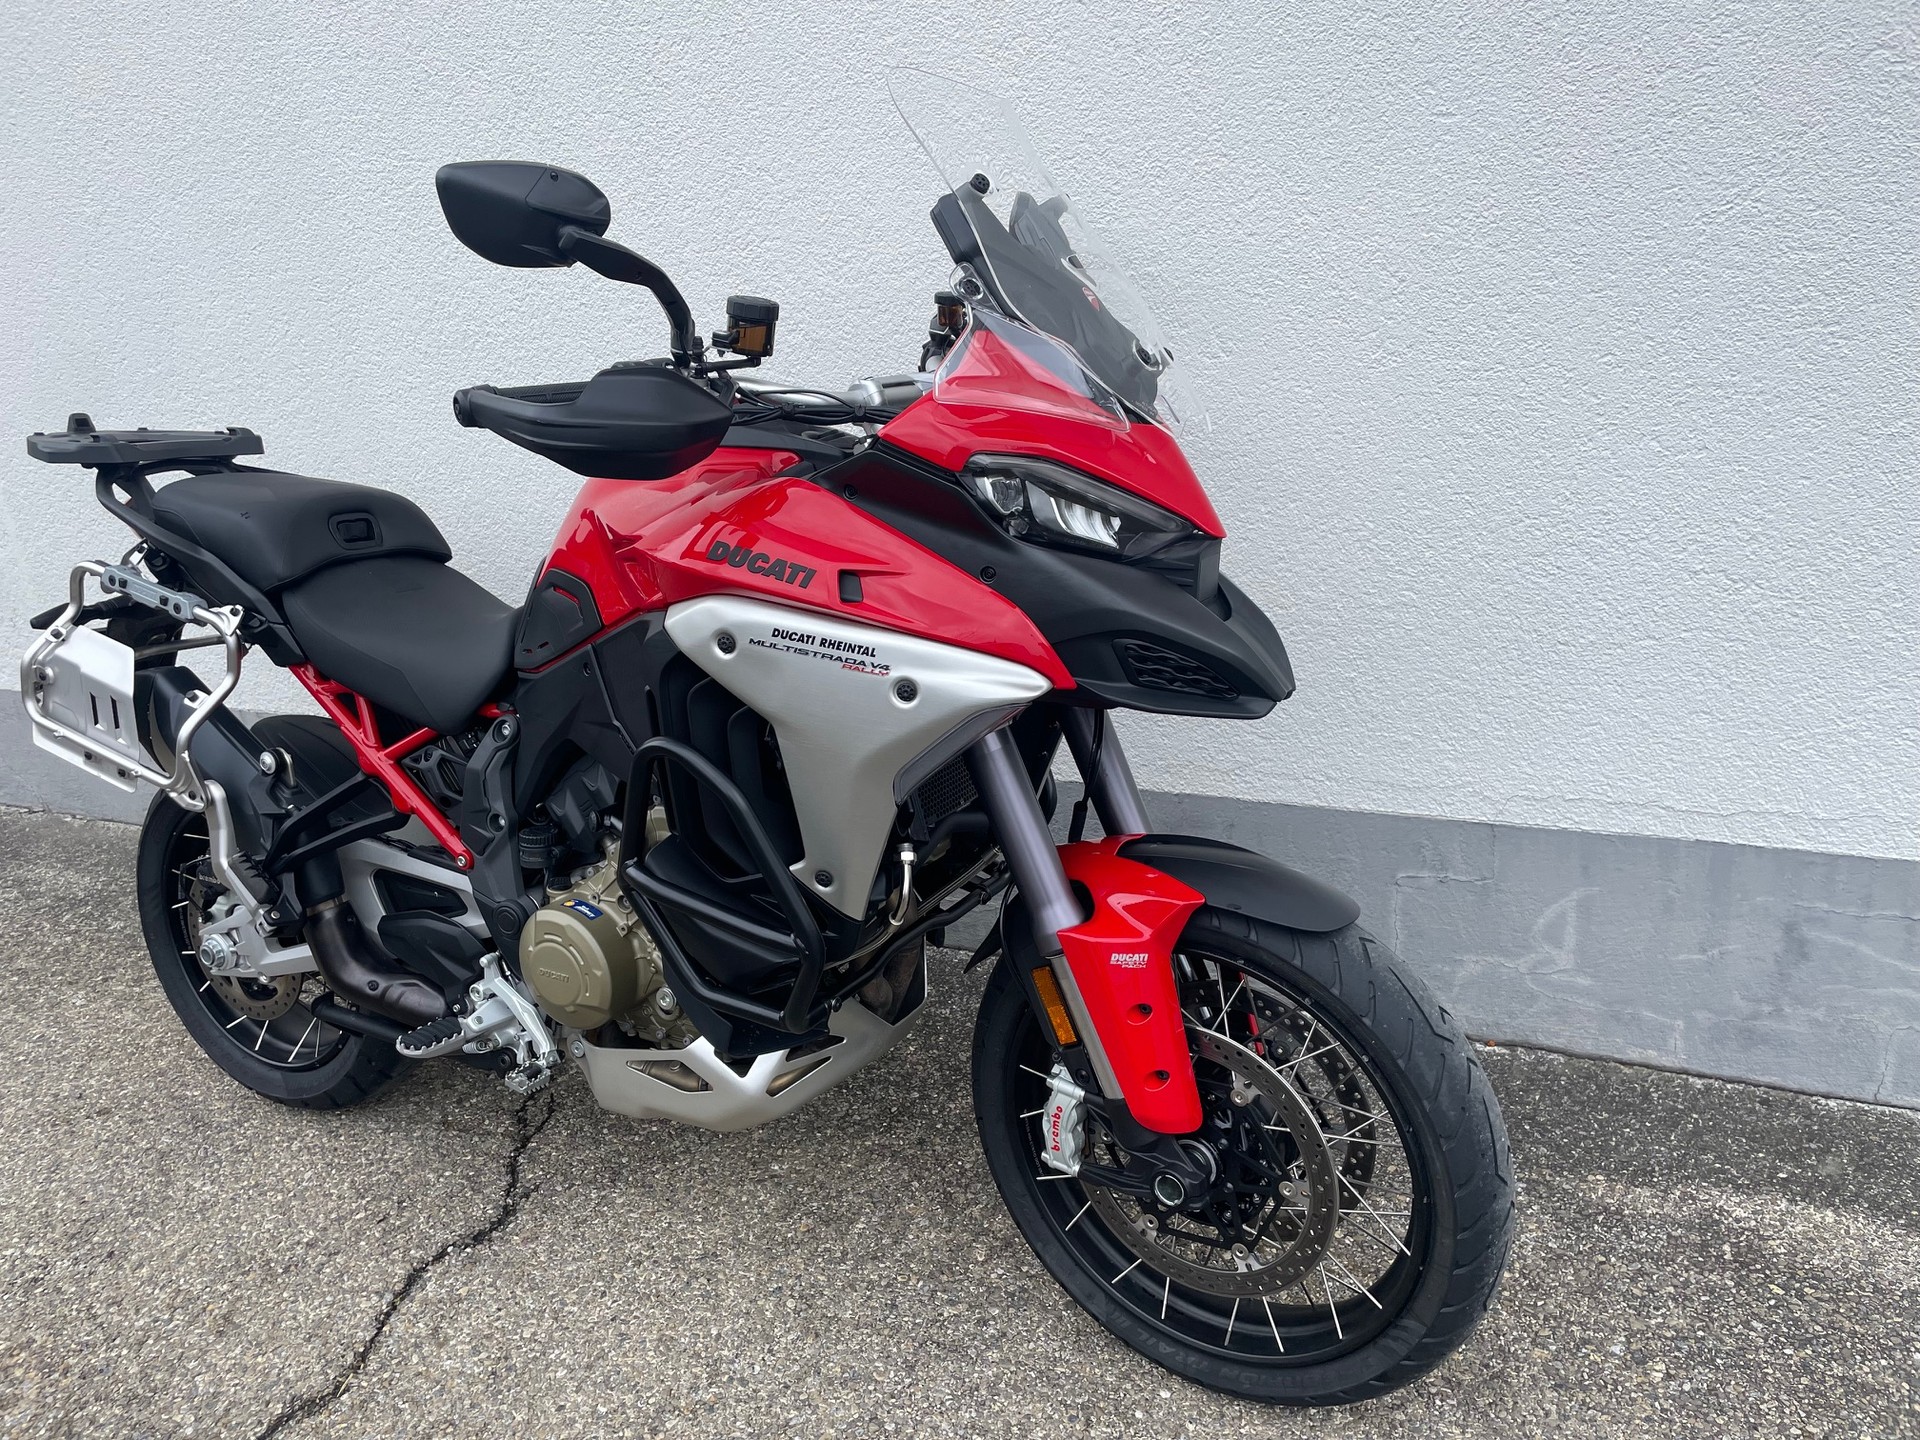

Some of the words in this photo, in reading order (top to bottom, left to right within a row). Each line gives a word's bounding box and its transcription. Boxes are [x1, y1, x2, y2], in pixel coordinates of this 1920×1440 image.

[706, 540, 817, 589] DUCATI
[748, 638, 867, 667] MULTISTRADA
[870, 661, 891, 671] V4
[771, 628, 816, 646] DUCATI
[819, 637, 876, 658] RHEINTAL
[841, 663, 890, 676] RALLY
[1111, 953, 1149, 962] DUCATI
[538, 967, 570, 983] DUCATI
[1051, 1105, 1063, 1152] brembo
